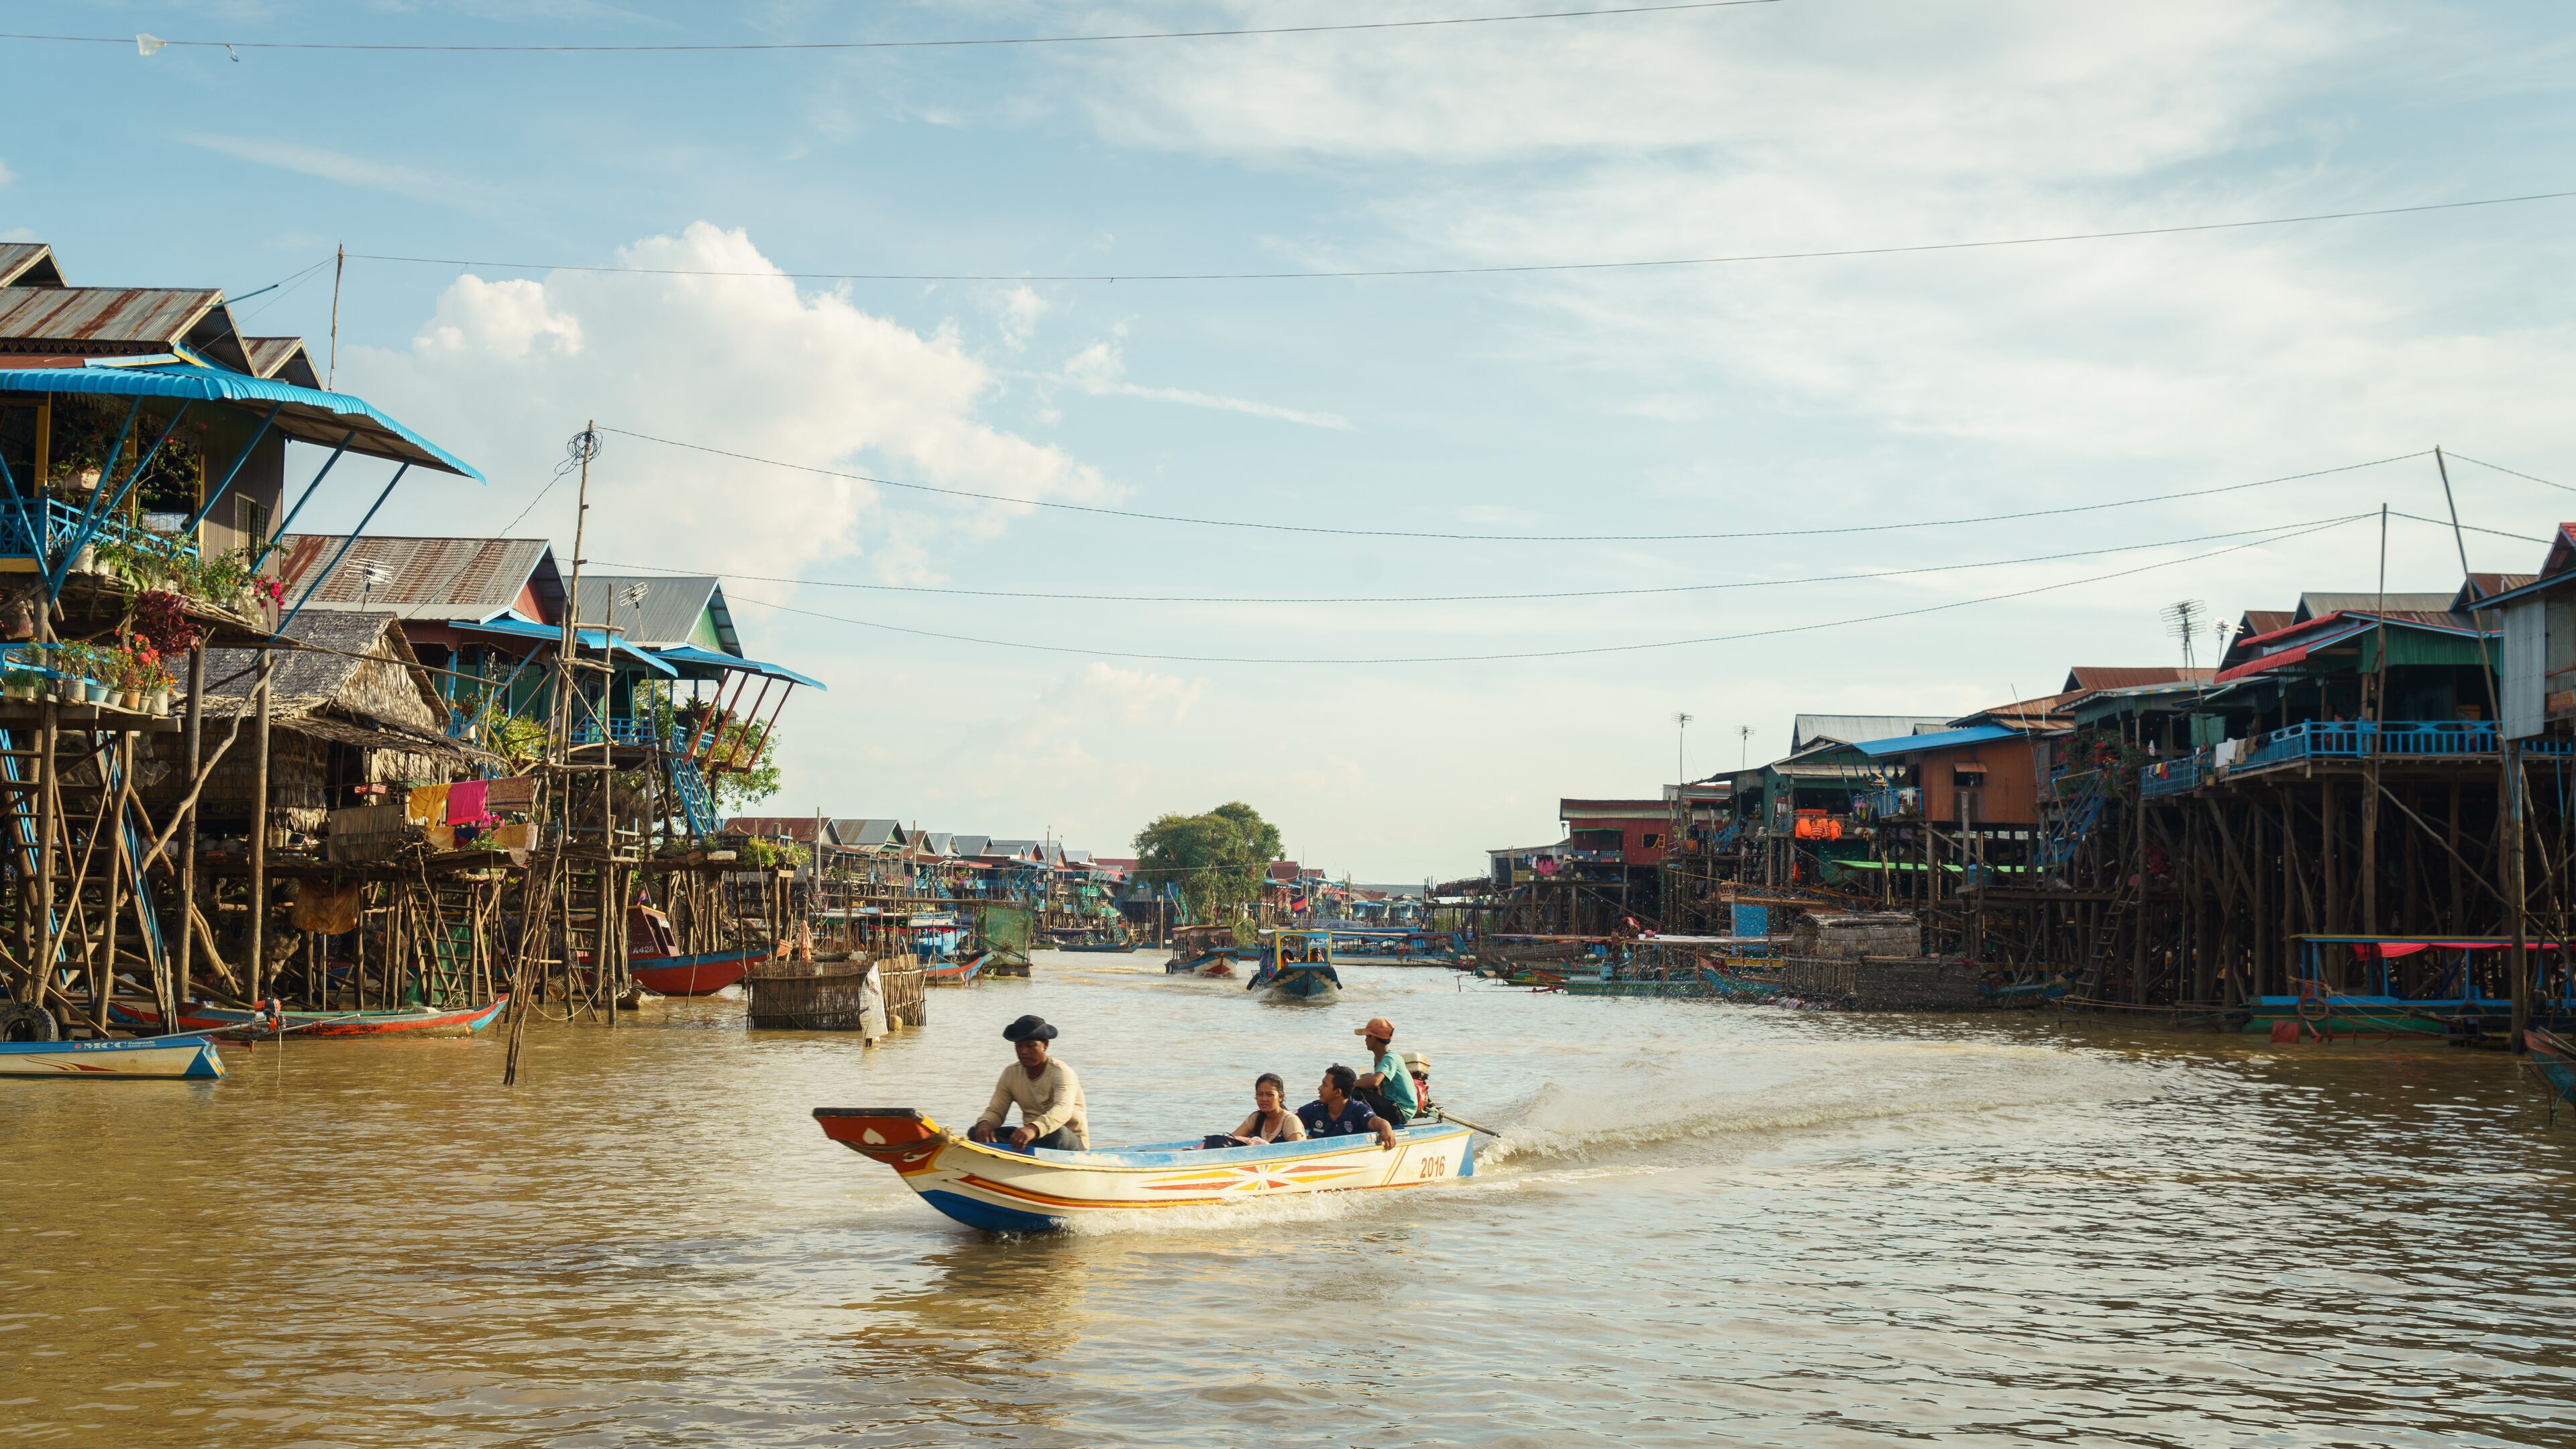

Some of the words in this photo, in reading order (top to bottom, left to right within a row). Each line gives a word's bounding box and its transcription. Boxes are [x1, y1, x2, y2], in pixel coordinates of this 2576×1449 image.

[633, 946, 654, 954] A428
[85, 1041, 127, 1049] MCC
[1419, 1155, 1446, 1179] 2016
